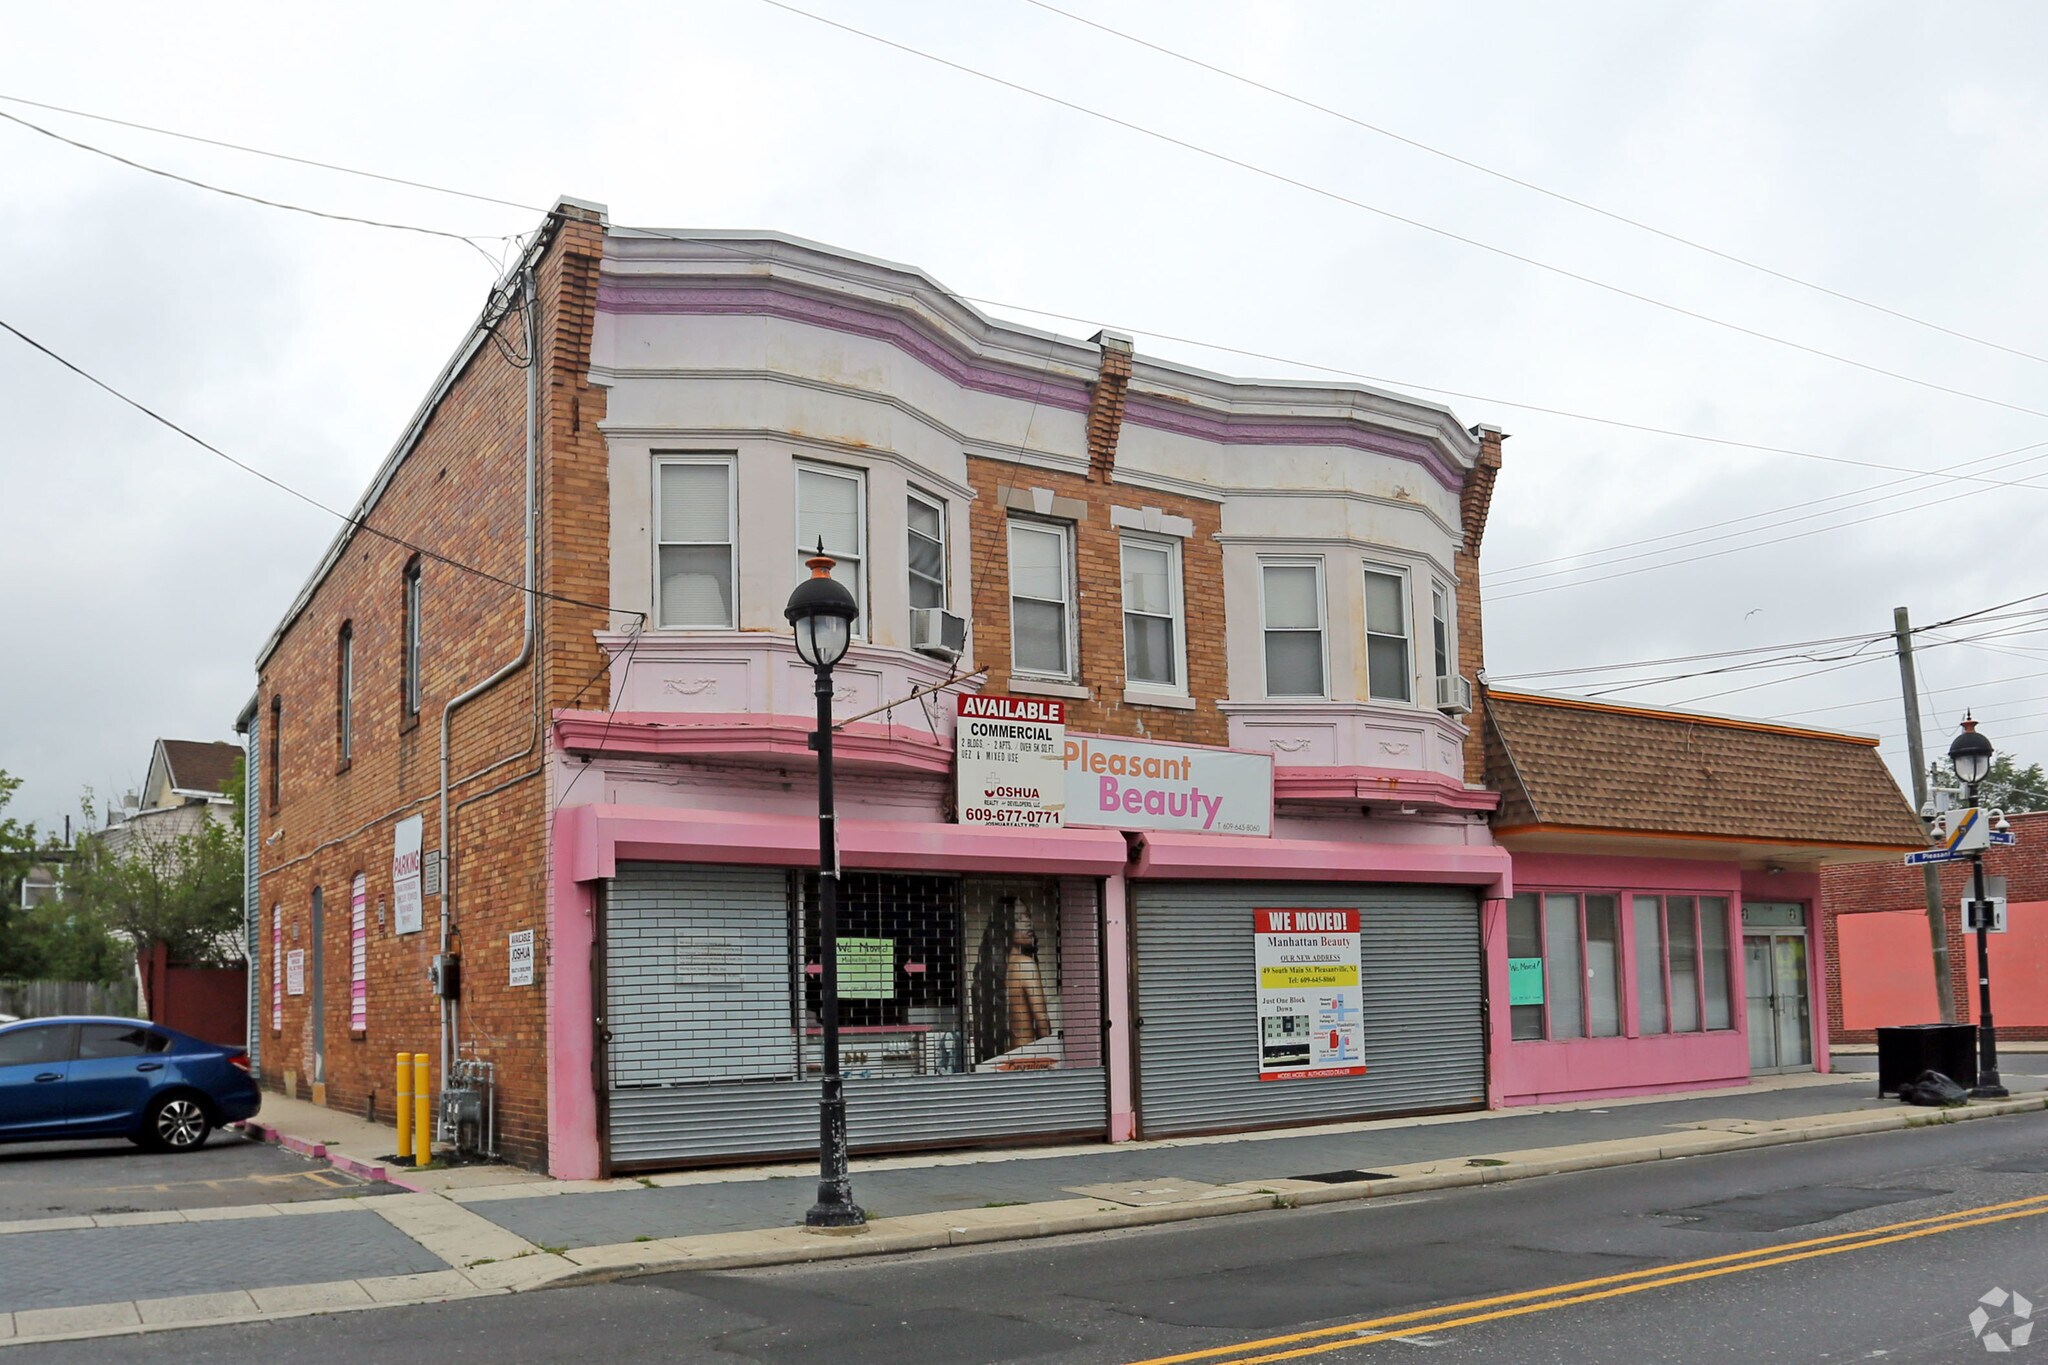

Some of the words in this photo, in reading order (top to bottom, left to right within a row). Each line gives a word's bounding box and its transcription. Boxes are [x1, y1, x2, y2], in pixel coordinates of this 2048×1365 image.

[963, 697, 1060, 722] AVAILABLE
[971, 723, 1052, 741] COMMERCIAL
[961, 738, 965, 748] 2
[994, 740, 998, 750] 2
[1020, 742, 1032, 752] OVER
[1033, 743, 1040, 752] 5K
[961, 750, 971, 759] UEZ
[986, 752, 1004, 762] MIXED
[1007, 753, 1019, 763] USE
[1063, 740, 1191, 781] Pleasant
[984, 777, 1040, 798] JOSHUA
[1099, 776, 1223, 829] Beauty
[966, 808, 1059, 823] 609-677-0771
[1223, 823, 1260, 832] 609-645-8060
[394, 850, 419, 877] PARKING
[1922, 851, 1951, 859] Pleasant
[1269, 912, 1291, 931] WE
[1295, 912, 1347, 931] MOVED!
[1268, 936, 1317, 947] Manhattan
[1321, 936, 1350, 948] Beauty
